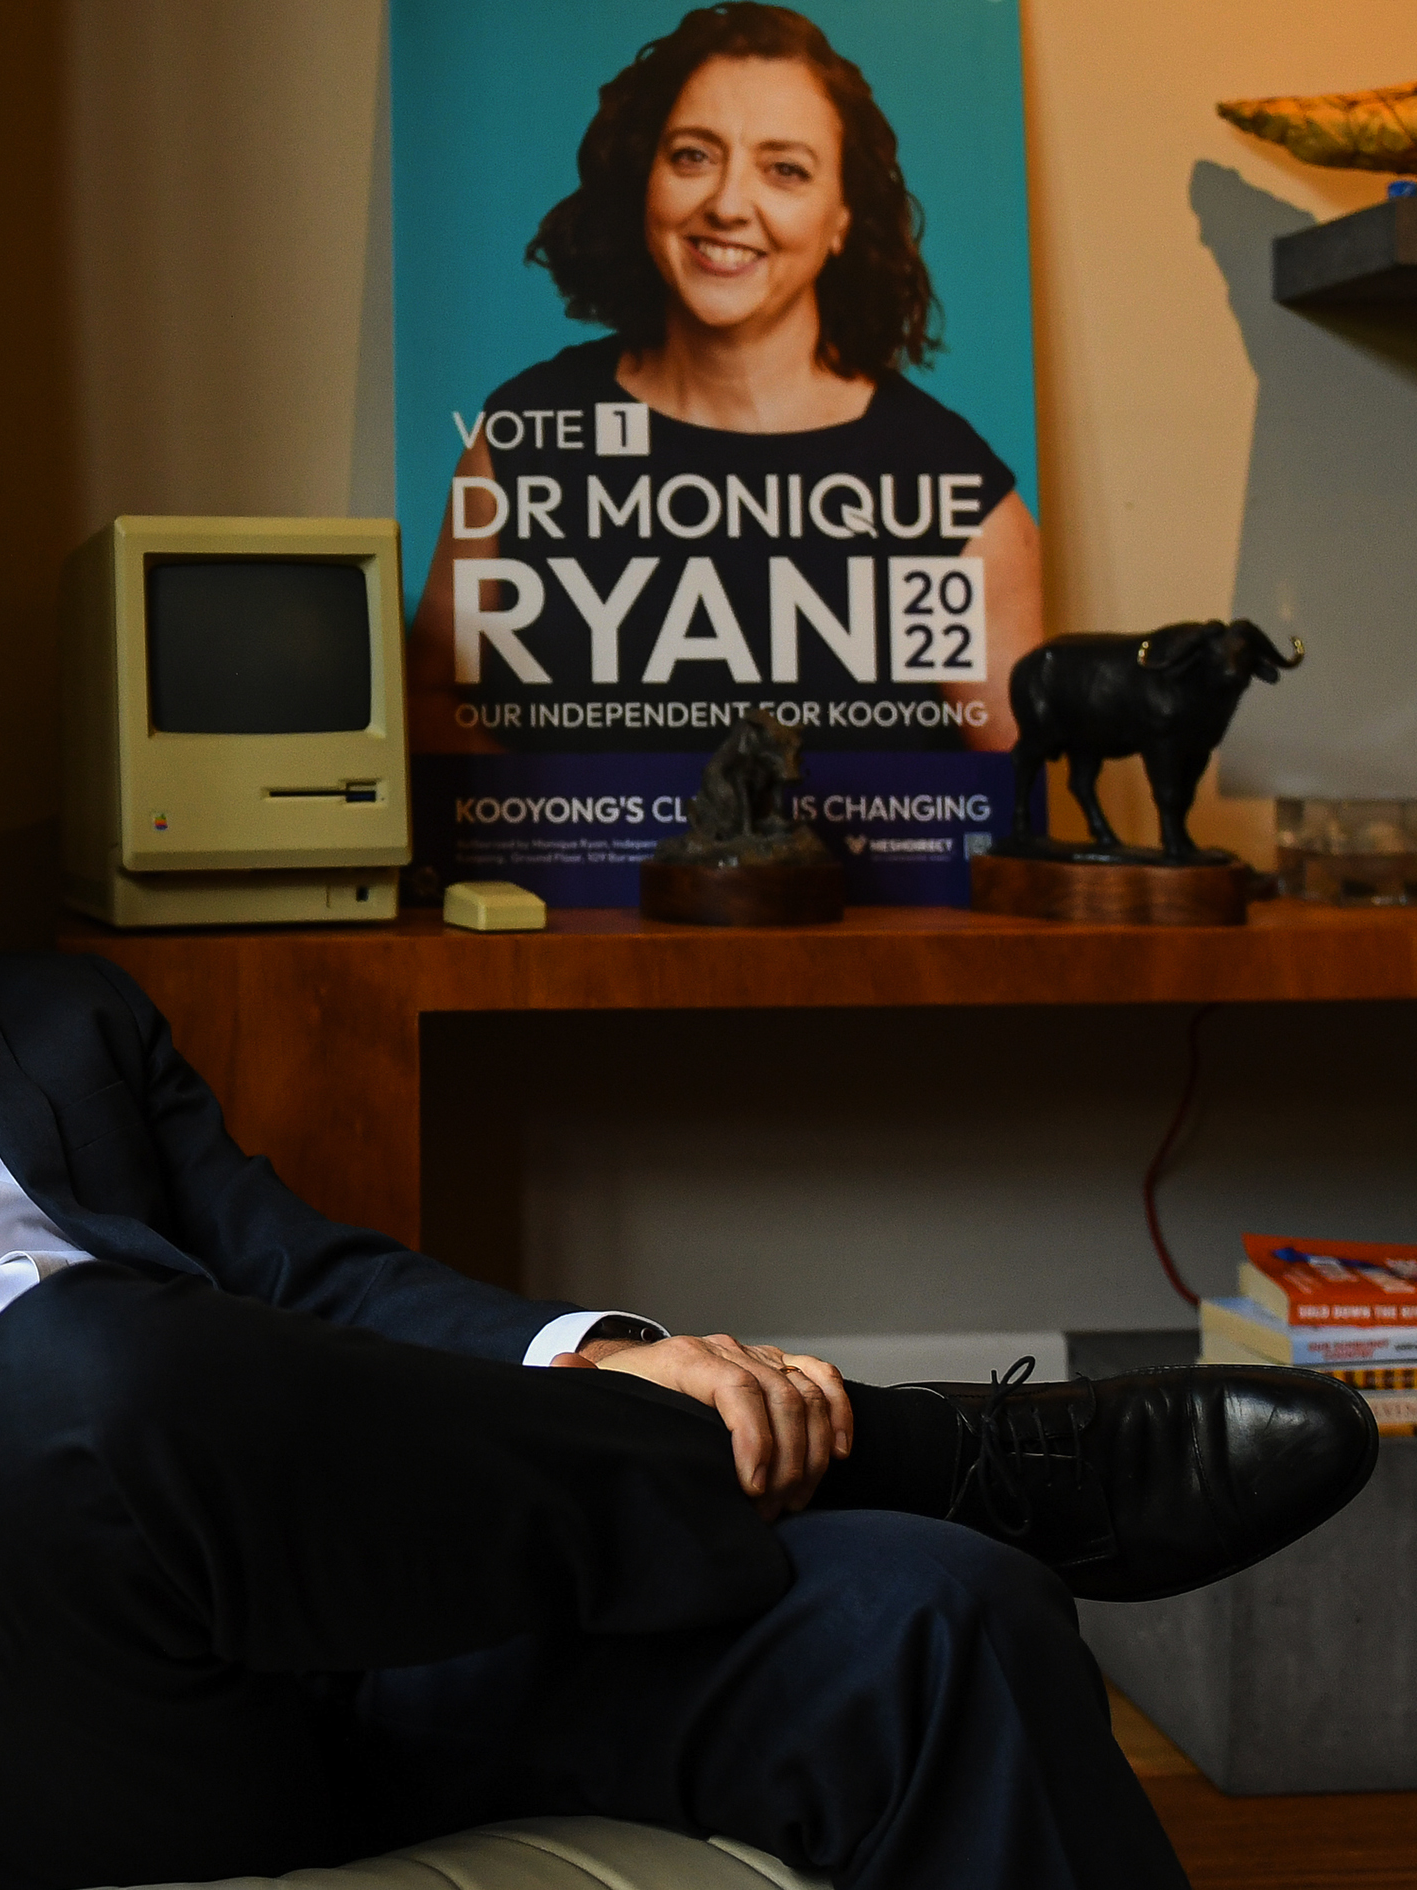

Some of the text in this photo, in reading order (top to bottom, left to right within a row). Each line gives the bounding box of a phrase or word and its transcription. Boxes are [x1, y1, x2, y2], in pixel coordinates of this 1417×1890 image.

[452, 410, 584, 450] VOTE
[451, 473, 983, 540] DR MONIQUE
[902, 570, 973, 615] 20
[452, 556, 877, 684] RYAN
[903, 624, 973, 669] 22
[454, 702, 522, 729] OUR
[530, 701, 751, 728] INDEPENDENT
[828, 701, 989, 728] KOOYONG
[454, 795, 644, 825] KOOYONG'S
[791, 795, 818, 822] IS
[823, 794, 992, 822] CHANGING
